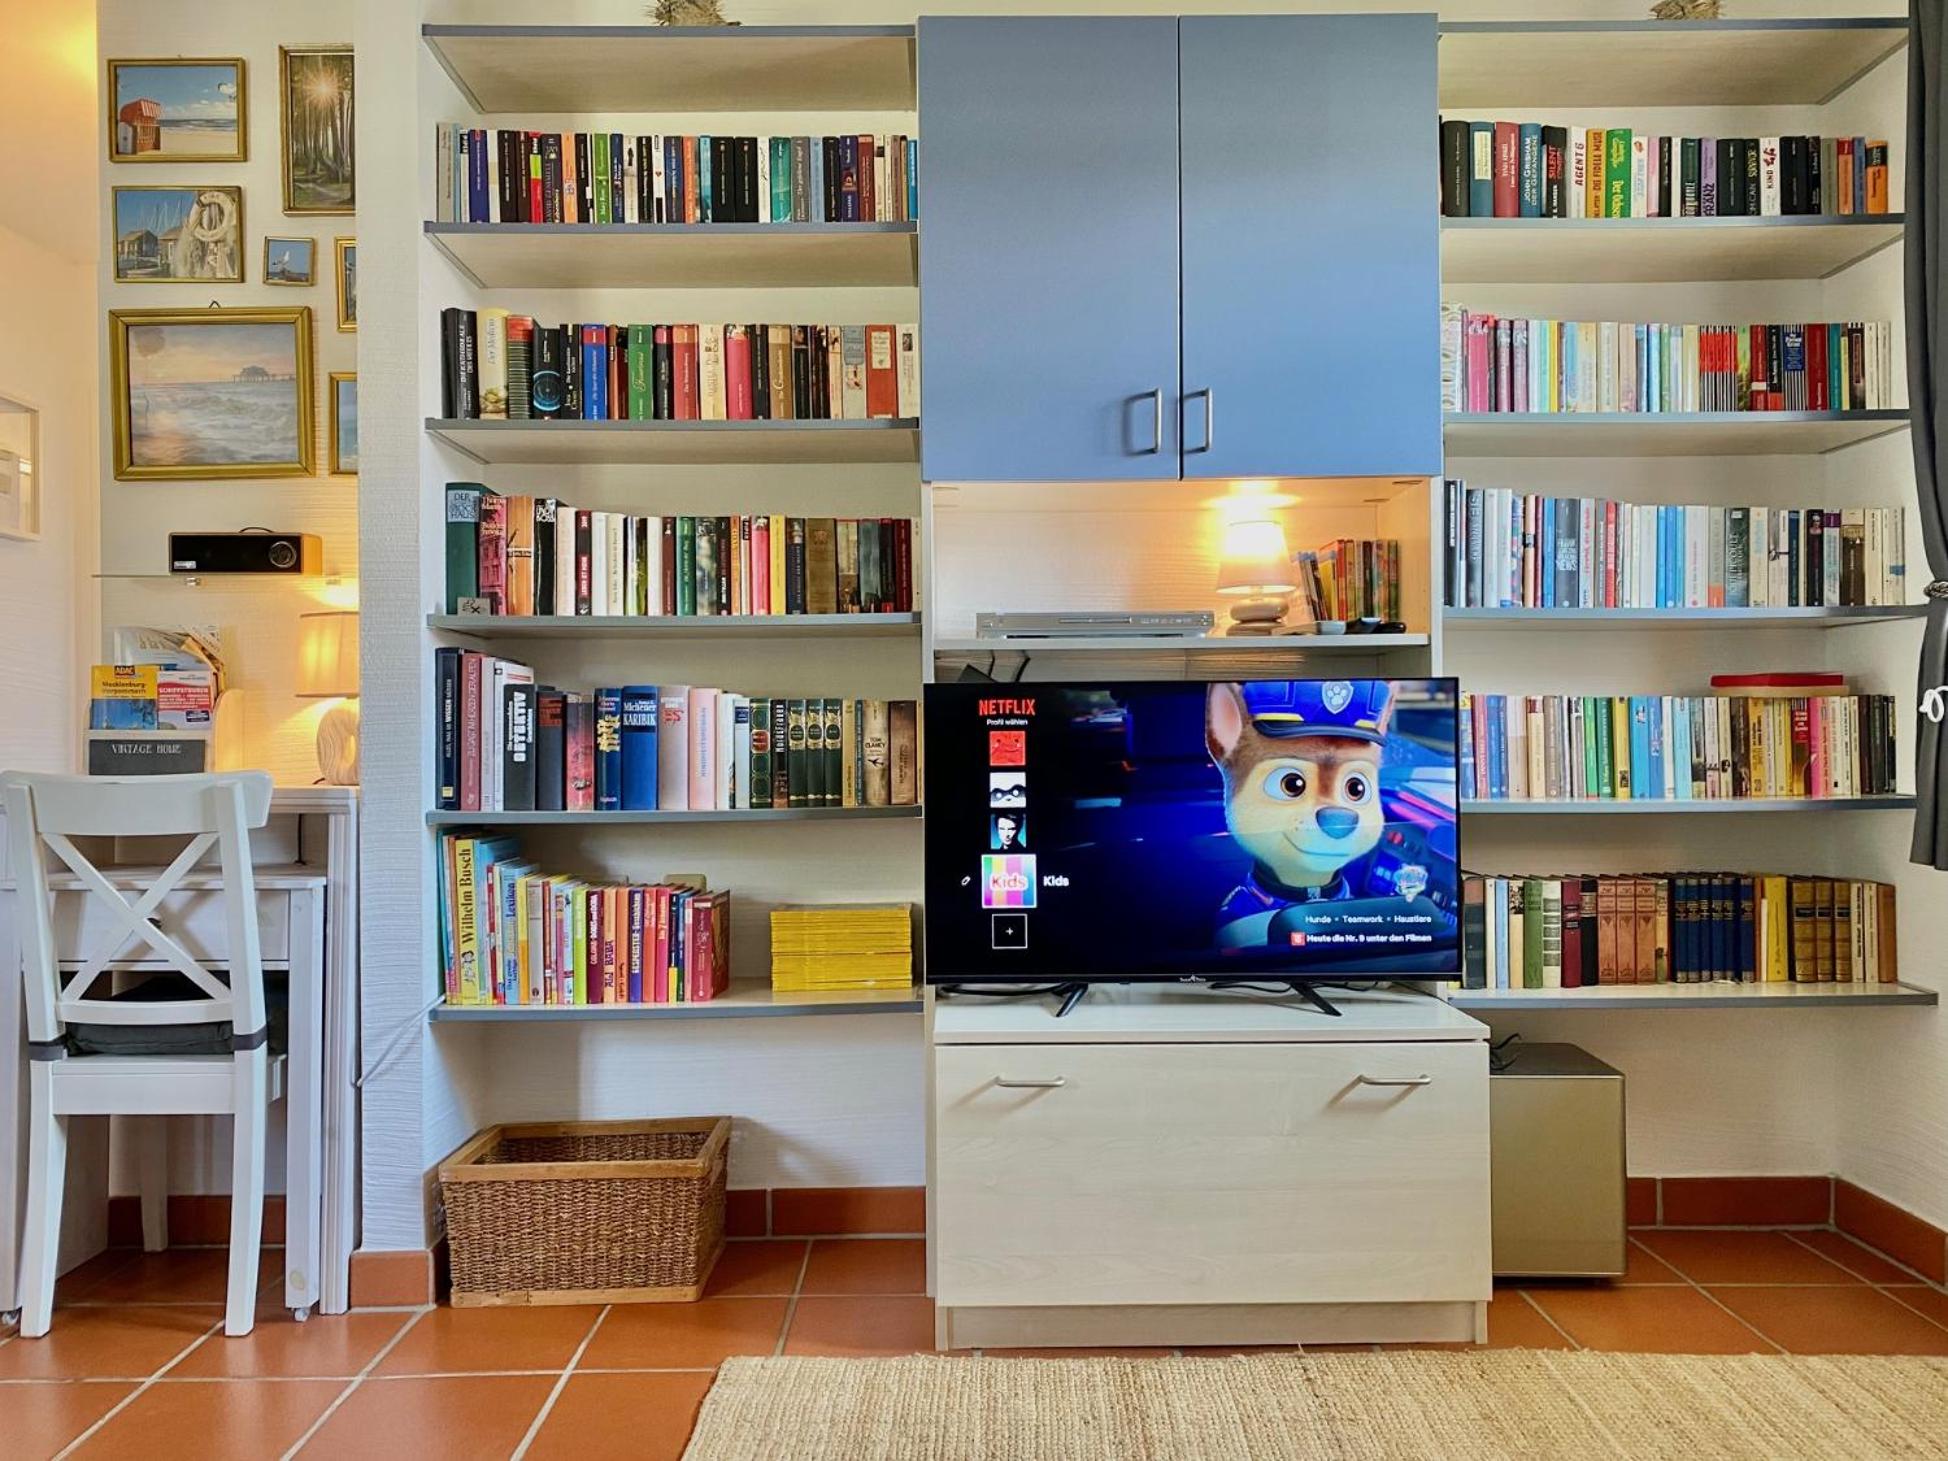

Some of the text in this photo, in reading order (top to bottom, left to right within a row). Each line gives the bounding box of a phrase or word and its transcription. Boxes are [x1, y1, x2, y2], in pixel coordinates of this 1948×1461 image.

[1523, 137, 1532, 201] JOHN GRISHAM
[1530, 135, 1538, 186] GEFANGENE
[1548, 145, 1556, 179] SILENT
[1574, 152, 1584, 186] AGENT
[1766, 169, 1774, 189] KIND
[624, 702, 656, 711] Michener
[978, 699, 1036, 716] NETFLIX
[513, 691, 526, 762] DETEKTIV
[623, 713, 656, 726] KARIBIK
[112, 744, 152, 754] VINTAGE
[992, 875, 1026, 889] Kids
[1043, 875, 1070, 887] Kids
[459, 848, 474, 944] Wilhelm Busch
[505, 883, 516, 918] Lexikon
[1305, 915, 1432, 923] Hunde Teamwork Haustiere
[1306, 934, 1331, 942] Heute
[604, 940, 613, 966] BABA
